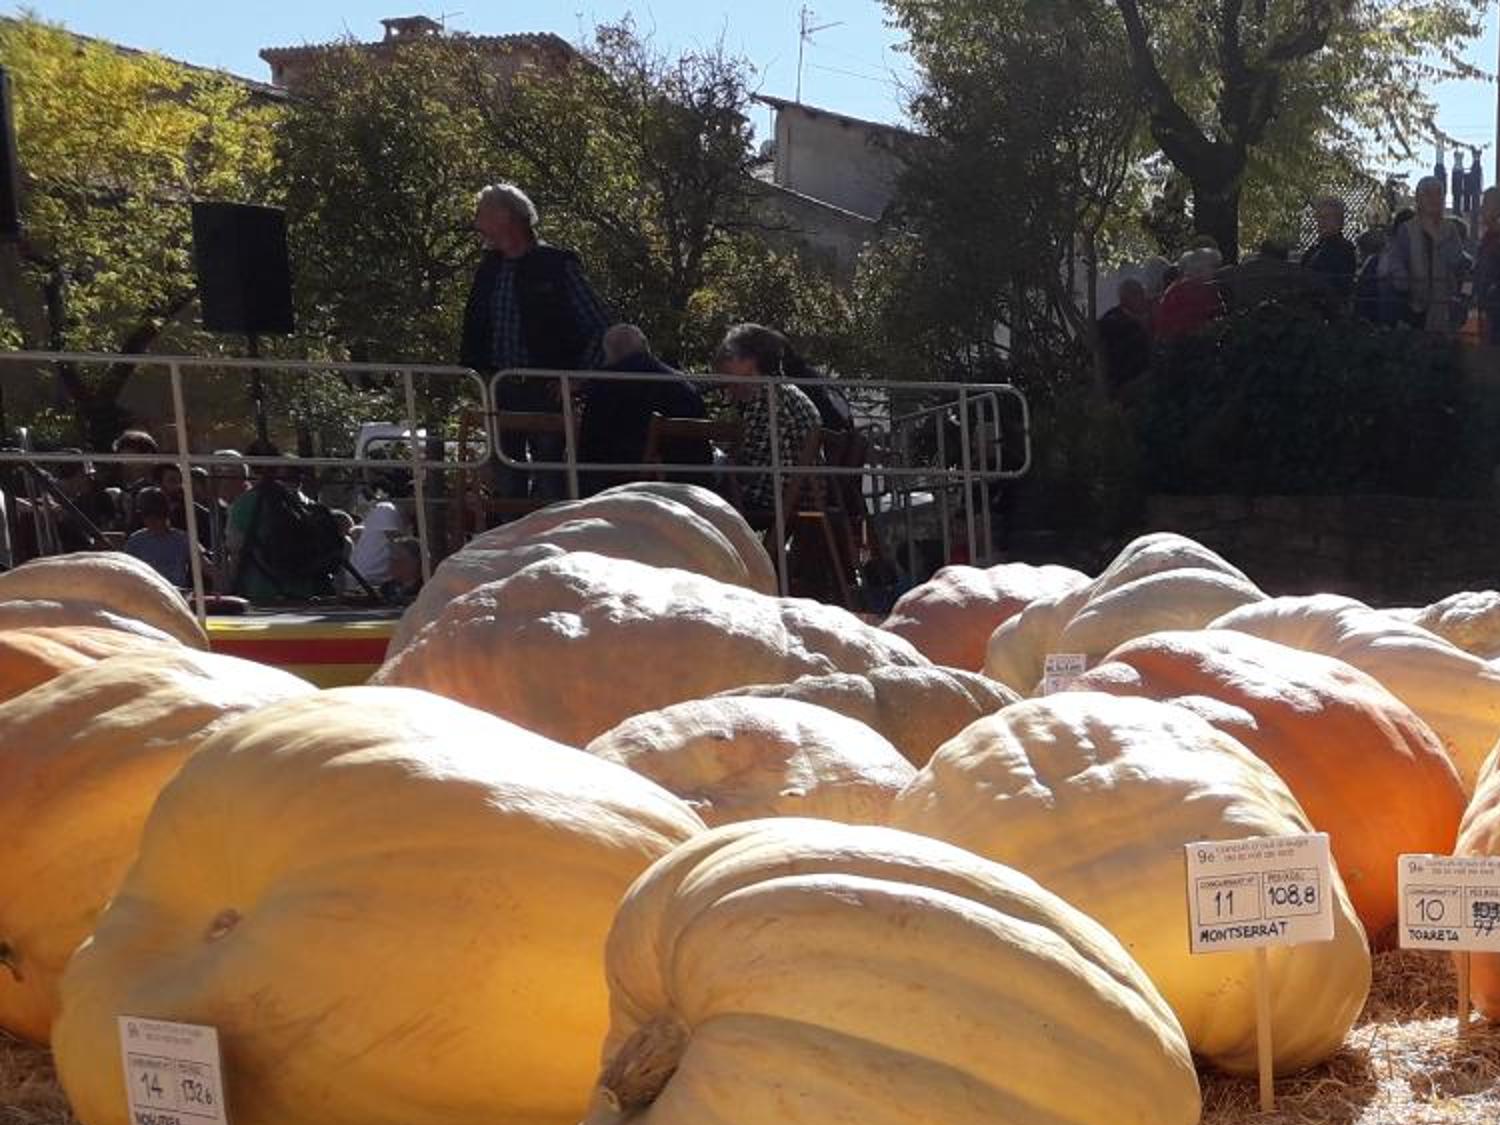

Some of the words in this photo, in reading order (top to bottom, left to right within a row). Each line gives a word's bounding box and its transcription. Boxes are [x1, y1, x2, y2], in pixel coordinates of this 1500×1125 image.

[1215, 890, 1234, 917] 11
[1268, 884, 1315, 907] 108,8
[1416, 898, 1445, 922] 10
[1200, 921, 1288, 943] MONTSERRAT
[141, 1072, 163, 1098] 14
